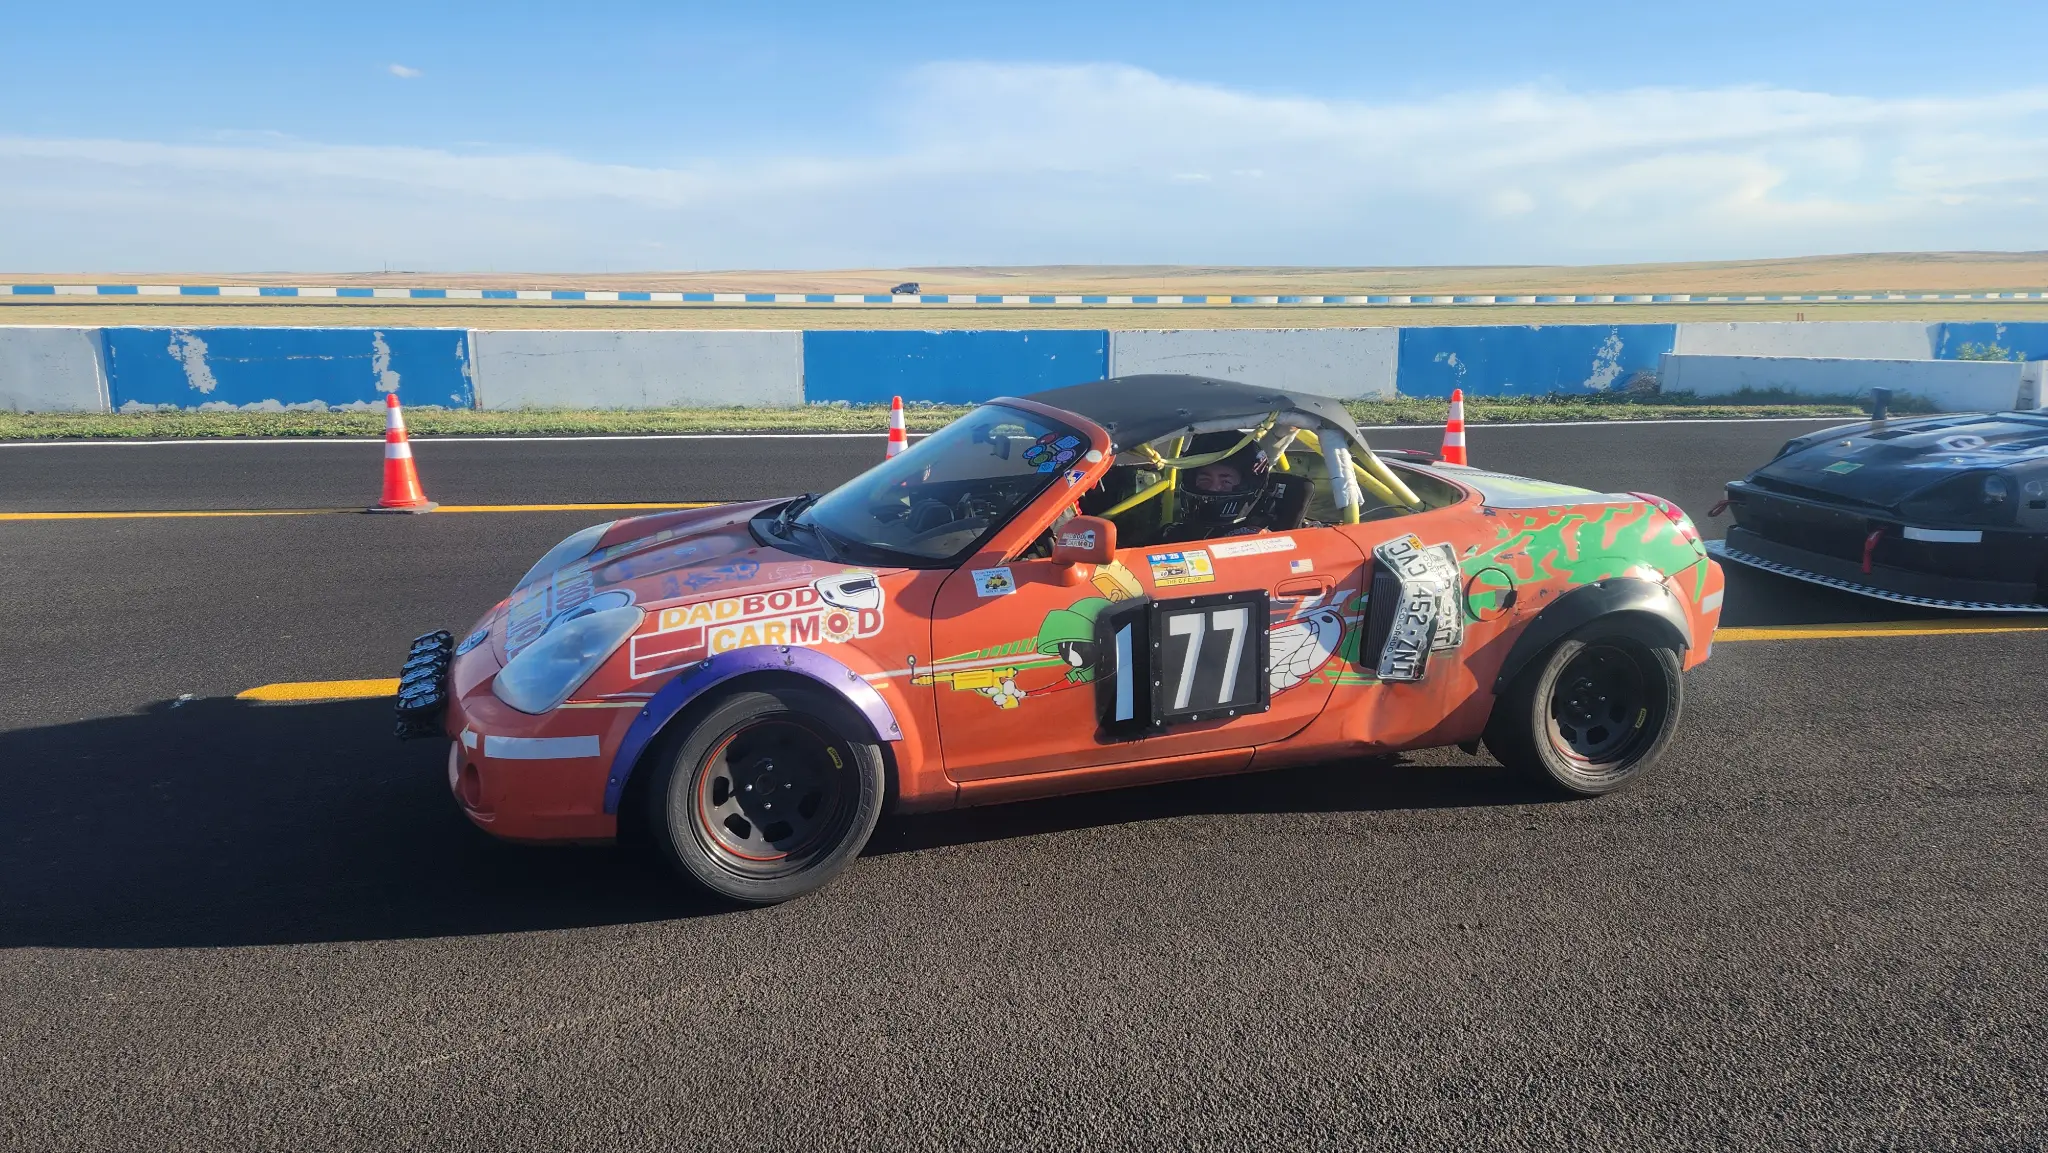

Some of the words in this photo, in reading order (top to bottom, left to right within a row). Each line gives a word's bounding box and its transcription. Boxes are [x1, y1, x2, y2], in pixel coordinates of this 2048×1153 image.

[1388, 542, 1428, 577] CVC
[711, 607, 881, 654] CARMOD
[1386, 606, 1408, 653] COLORADO
